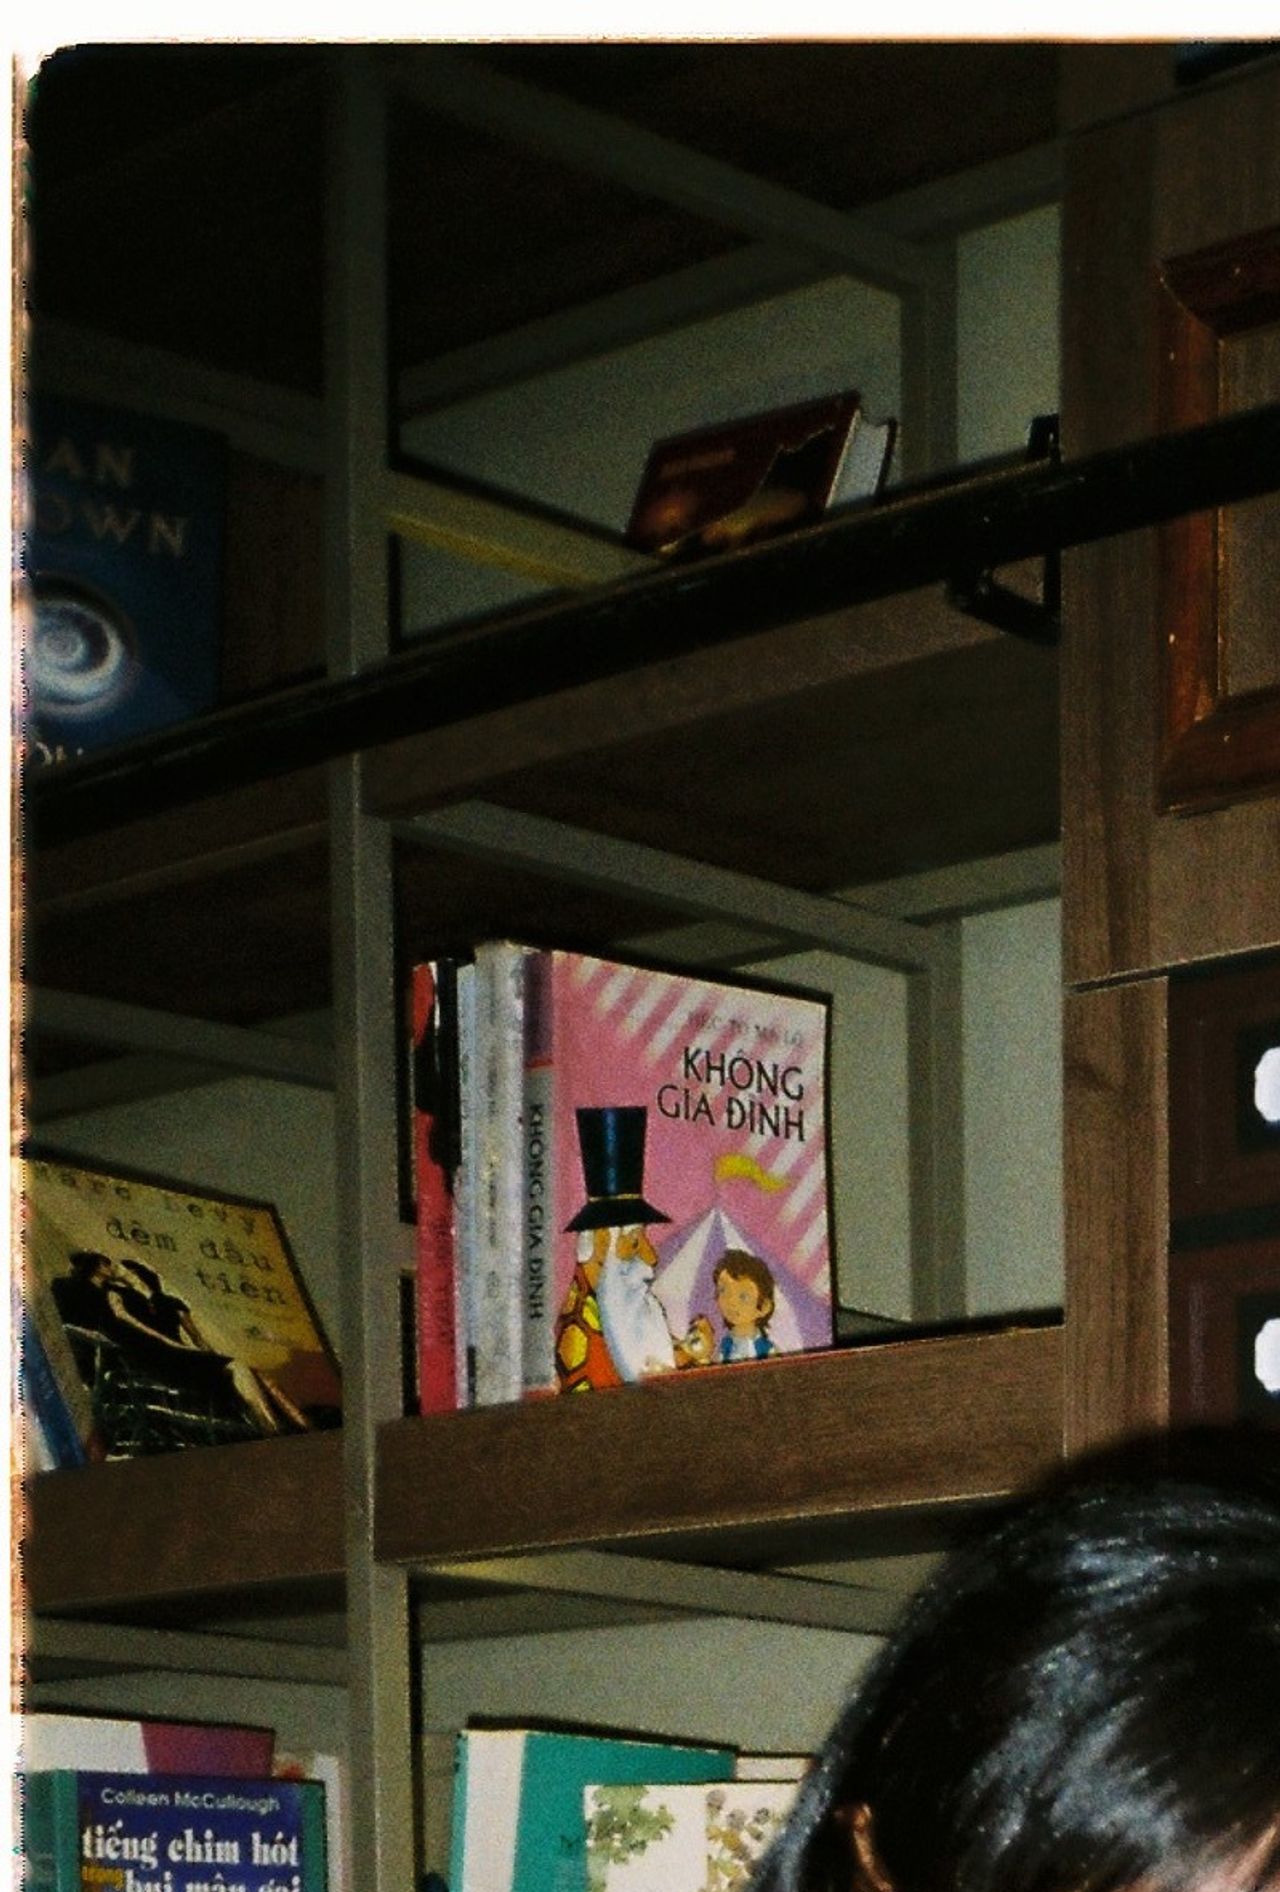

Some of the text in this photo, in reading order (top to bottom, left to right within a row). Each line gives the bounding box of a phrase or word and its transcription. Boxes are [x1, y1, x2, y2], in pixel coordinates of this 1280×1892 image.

[45, 438, 134, 487] AN
[38, 493, 192, 557] OWN
[683, 1045, 804, 1101] KHÔNG
[656, 1083, 716, 1126] GIA
[528, 1202, 546, 1256] GIA
[100, 1786, 281, 1815] Colleen McCullough
[81, 1818, 299, 1870] tiếng chim hót
